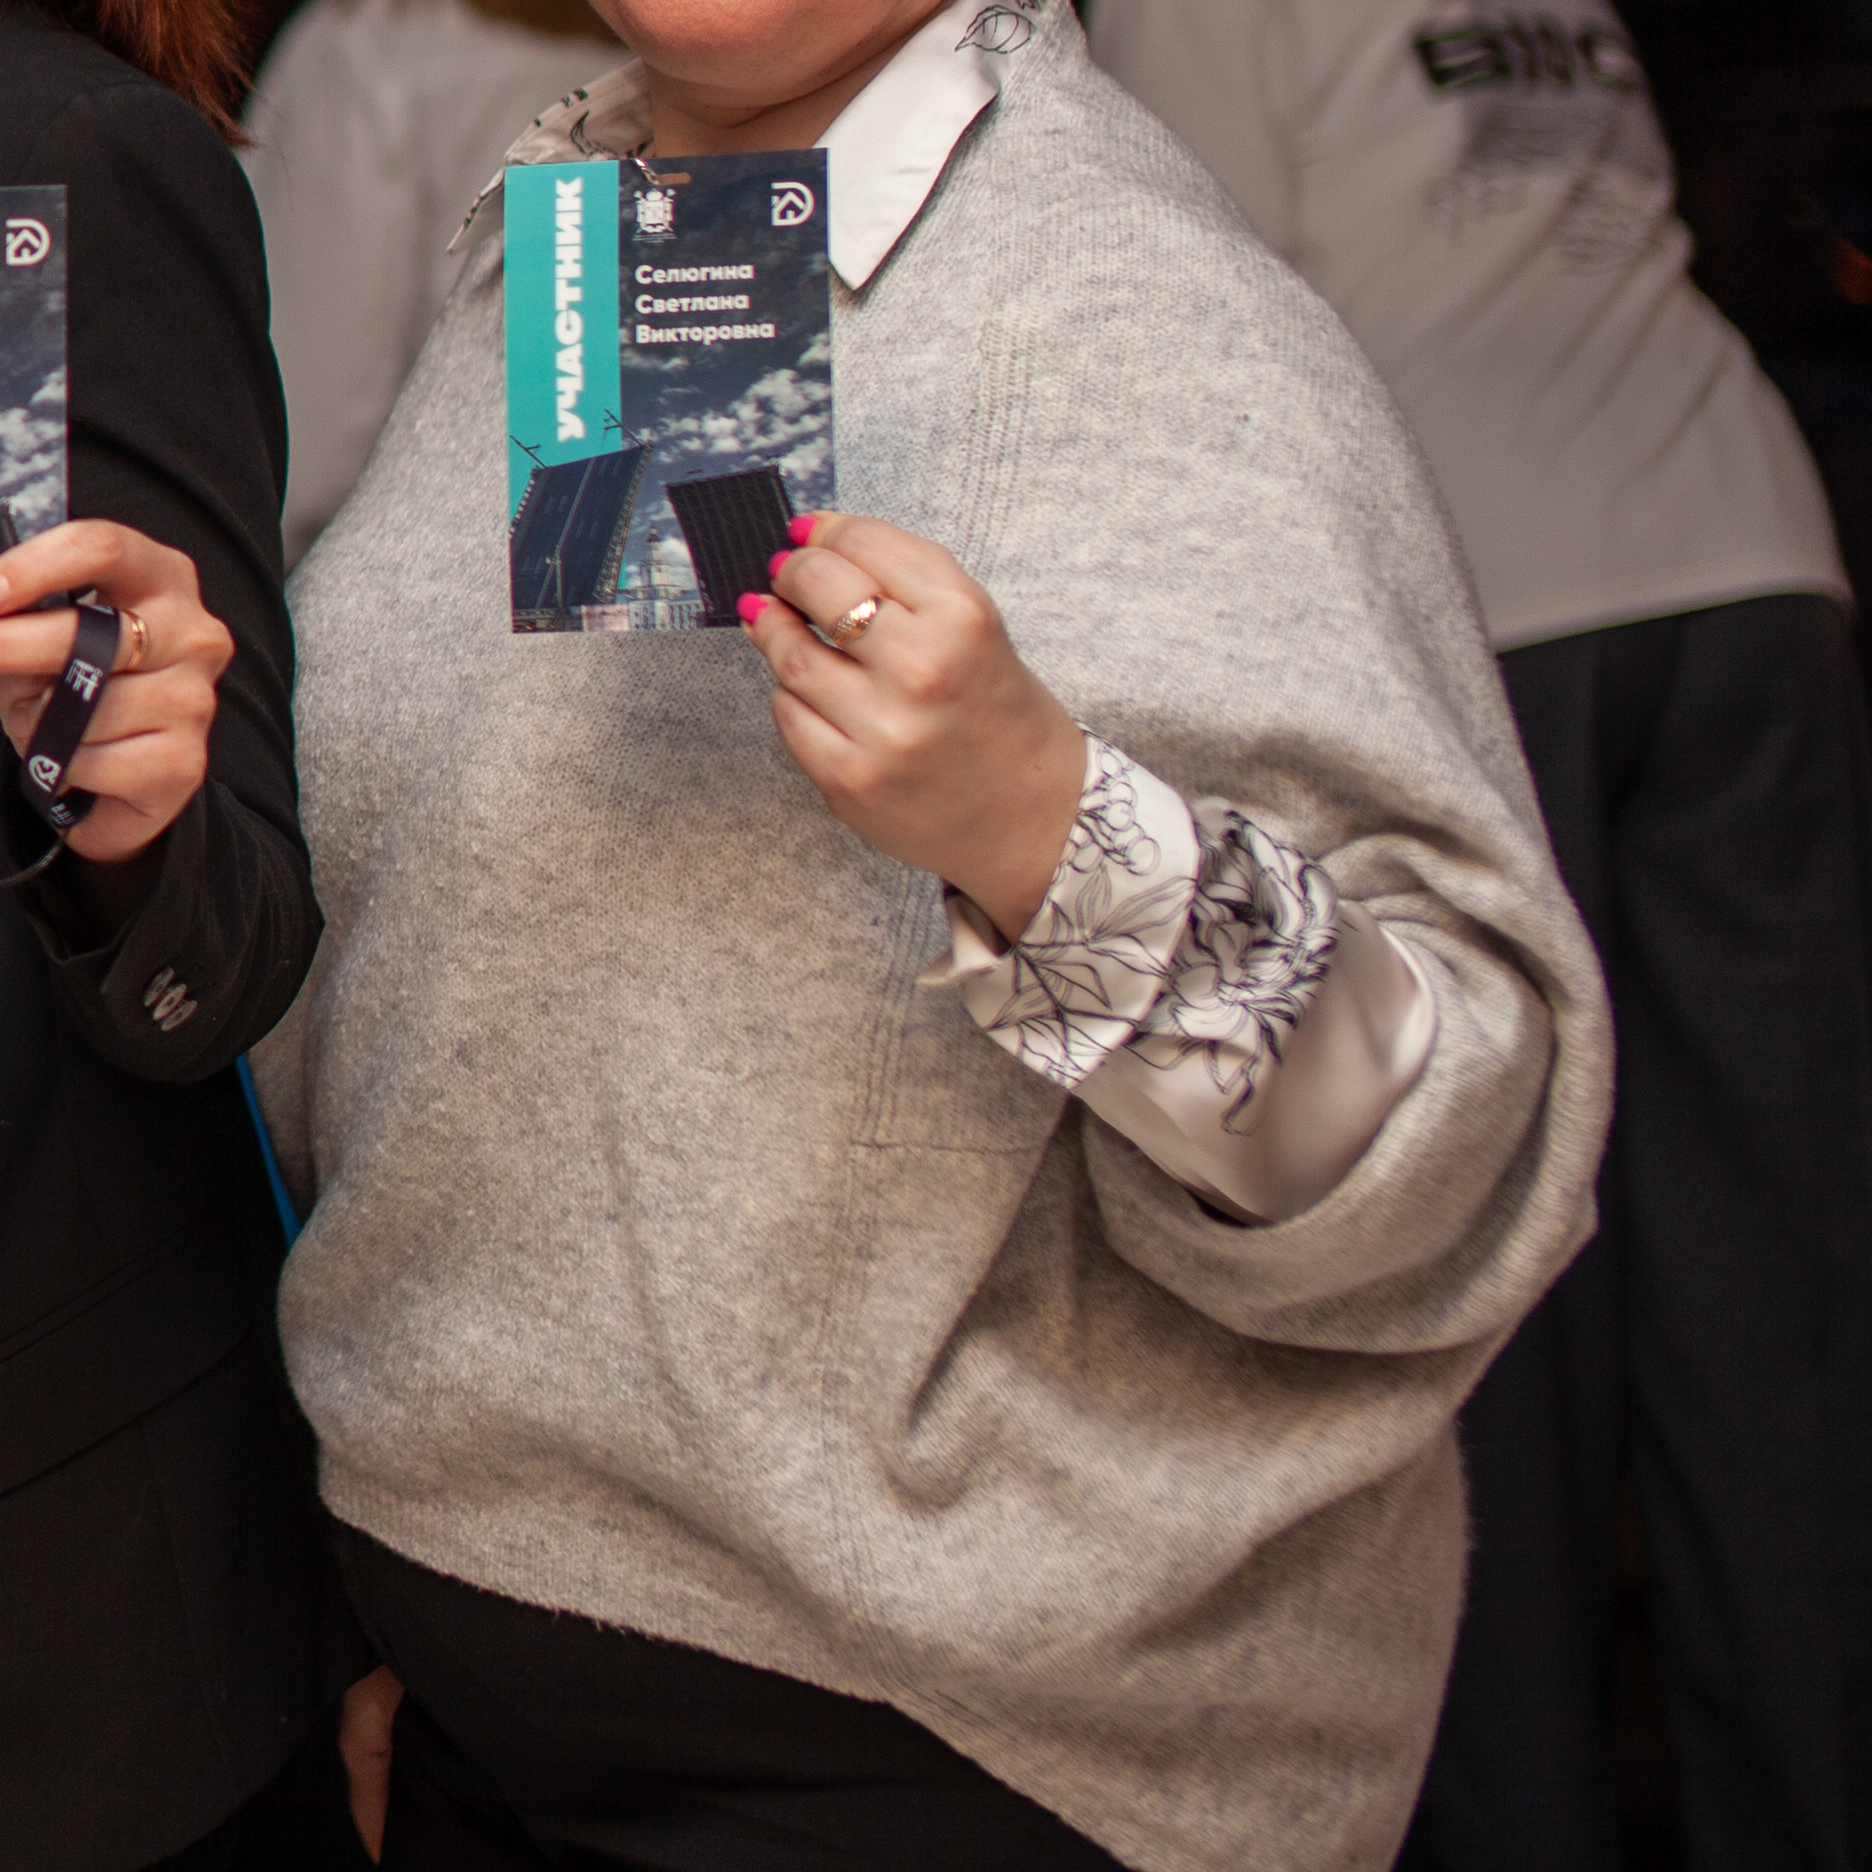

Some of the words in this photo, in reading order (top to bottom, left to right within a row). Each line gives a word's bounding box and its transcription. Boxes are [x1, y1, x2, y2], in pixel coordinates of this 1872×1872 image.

[634, 264, 754, 285] Селюгина
[555, 176, 586, 443] УЧАСТНИК
[634, 294, 750, 315] Светлана
[635, 323, 775, 346] Викторовна
